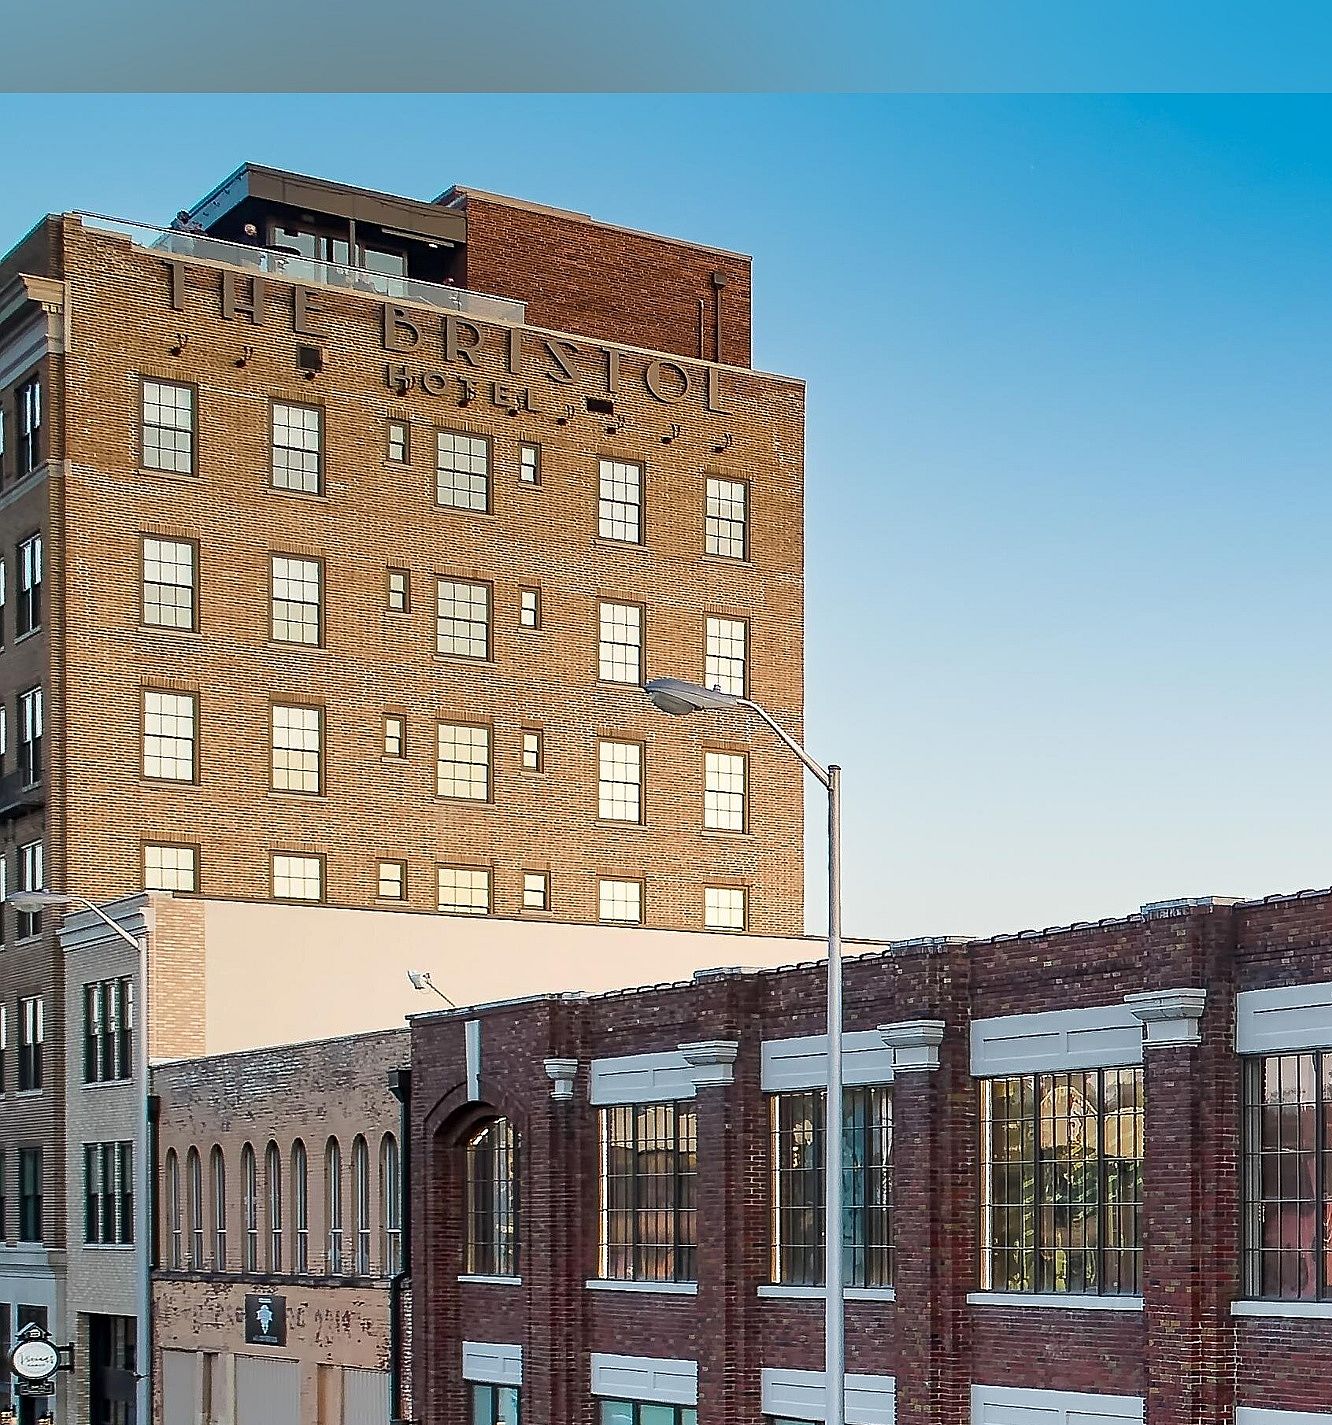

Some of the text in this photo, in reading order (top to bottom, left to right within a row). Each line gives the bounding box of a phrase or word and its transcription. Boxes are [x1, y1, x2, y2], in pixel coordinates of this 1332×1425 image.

[165, 260, 734, 415] THE BRISTOL
[387, 364, 543, 413] HOTEL
